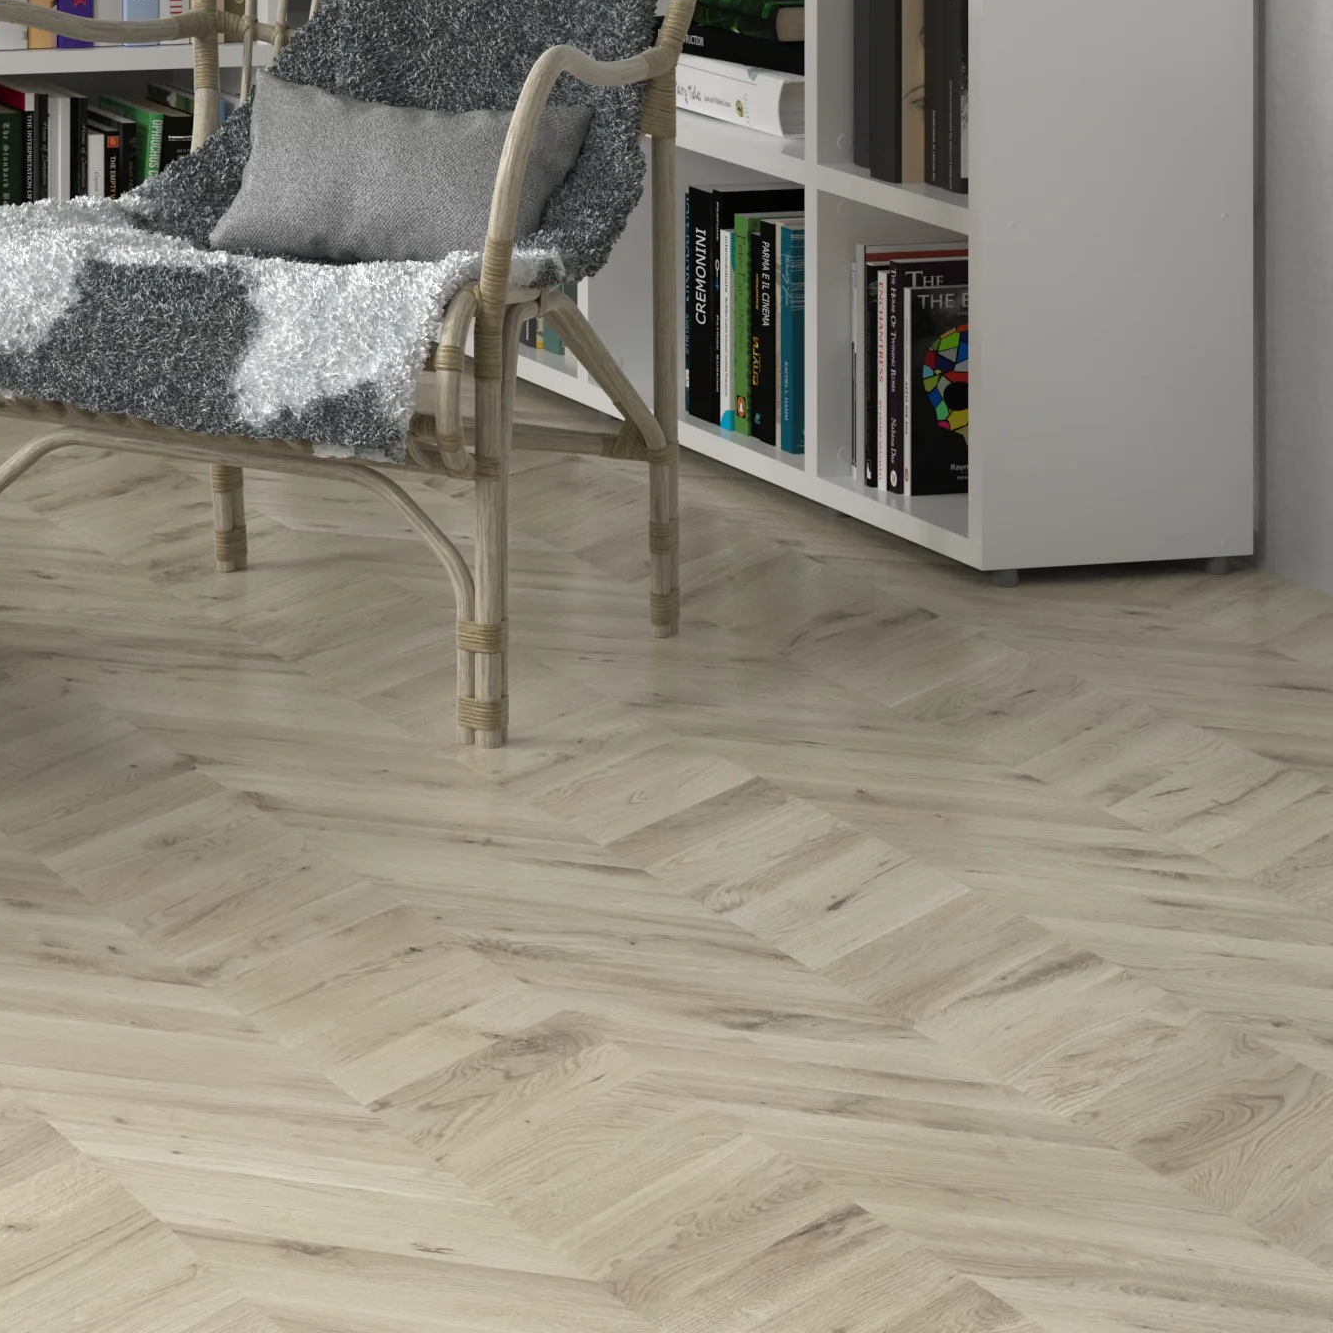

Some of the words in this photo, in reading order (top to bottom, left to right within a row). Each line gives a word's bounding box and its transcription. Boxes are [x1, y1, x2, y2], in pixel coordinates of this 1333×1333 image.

[26, 114, 34, 129] THE
[148, 119, 163, 168] OPHIUCHUS
[26, 129, 34, 189] INTERPRETATION
[26, 189, 34, 201] OF
[761, 241, 771, 271] PARMA
[695, 226, 707, 325] CREMONINI
[761, 272, 771, 280] E
[761, 281, 771, 291] IL
[761, 292, 771, 327] CINEMA
[917, 294, 956, 310] THE
